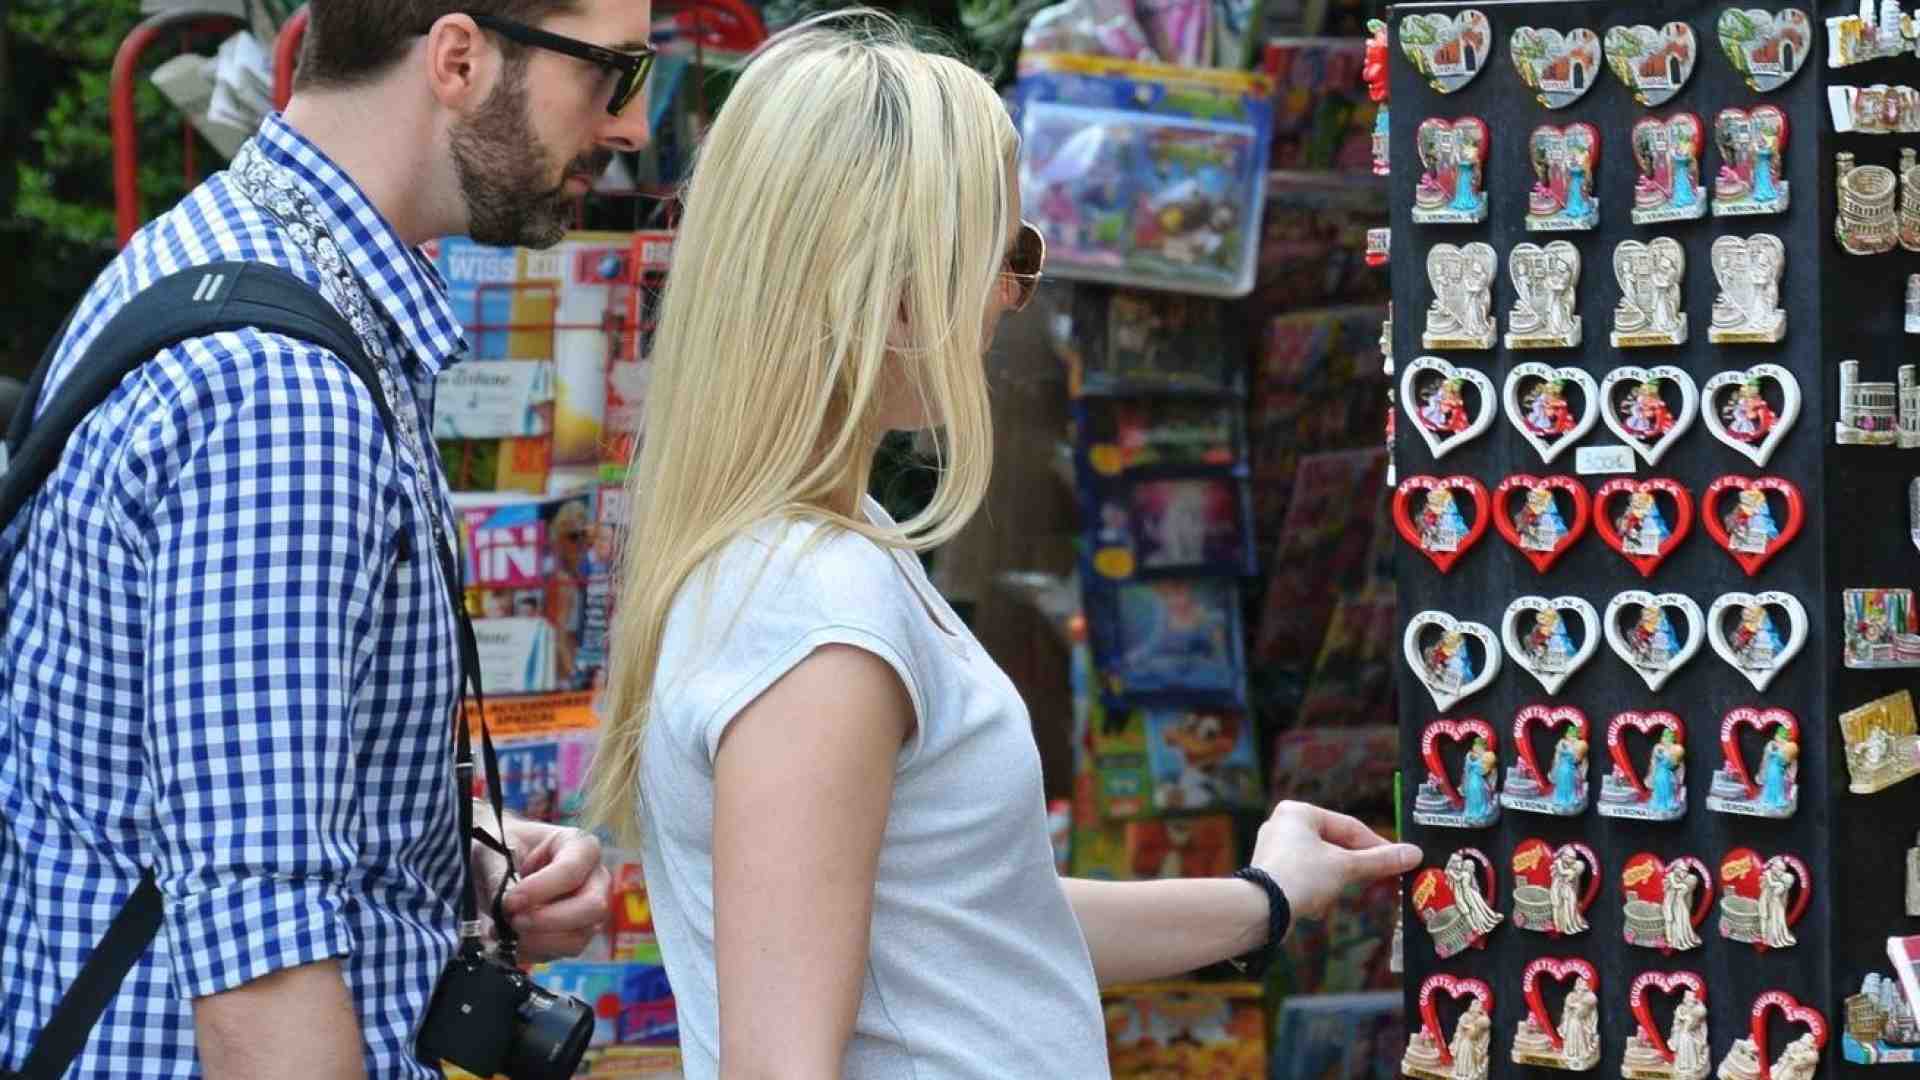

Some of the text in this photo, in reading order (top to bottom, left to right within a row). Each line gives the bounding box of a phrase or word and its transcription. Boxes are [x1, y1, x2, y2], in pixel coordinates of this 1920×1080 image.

[1413, 359, 1485, 392] VERONA
[1513, 367, 1587, 385] VERONA
[1606, 367, 1682, 383] VERONA
[1708, 366, 1780, 391] VERONA
[1398, 477, 1476, 495] VERONA
[1498, 476, 1578, 494] VERONA
[1599, 479, 1680, 496] VERONA
[1709, 476, 1794, 496] VERONA
[1509, 598, 1585, 614] VERONA
[1613, 594, 1690, 610] VERONA
[1714, 593, 1792, 609] VERONA
[1415, 614, 1489, 643] VERONA
[1513, 800, 1549, 810] VERONA
[1612, 808, 1647, 817] VERONA
[1720, 803, 1755, 812] VERONA
